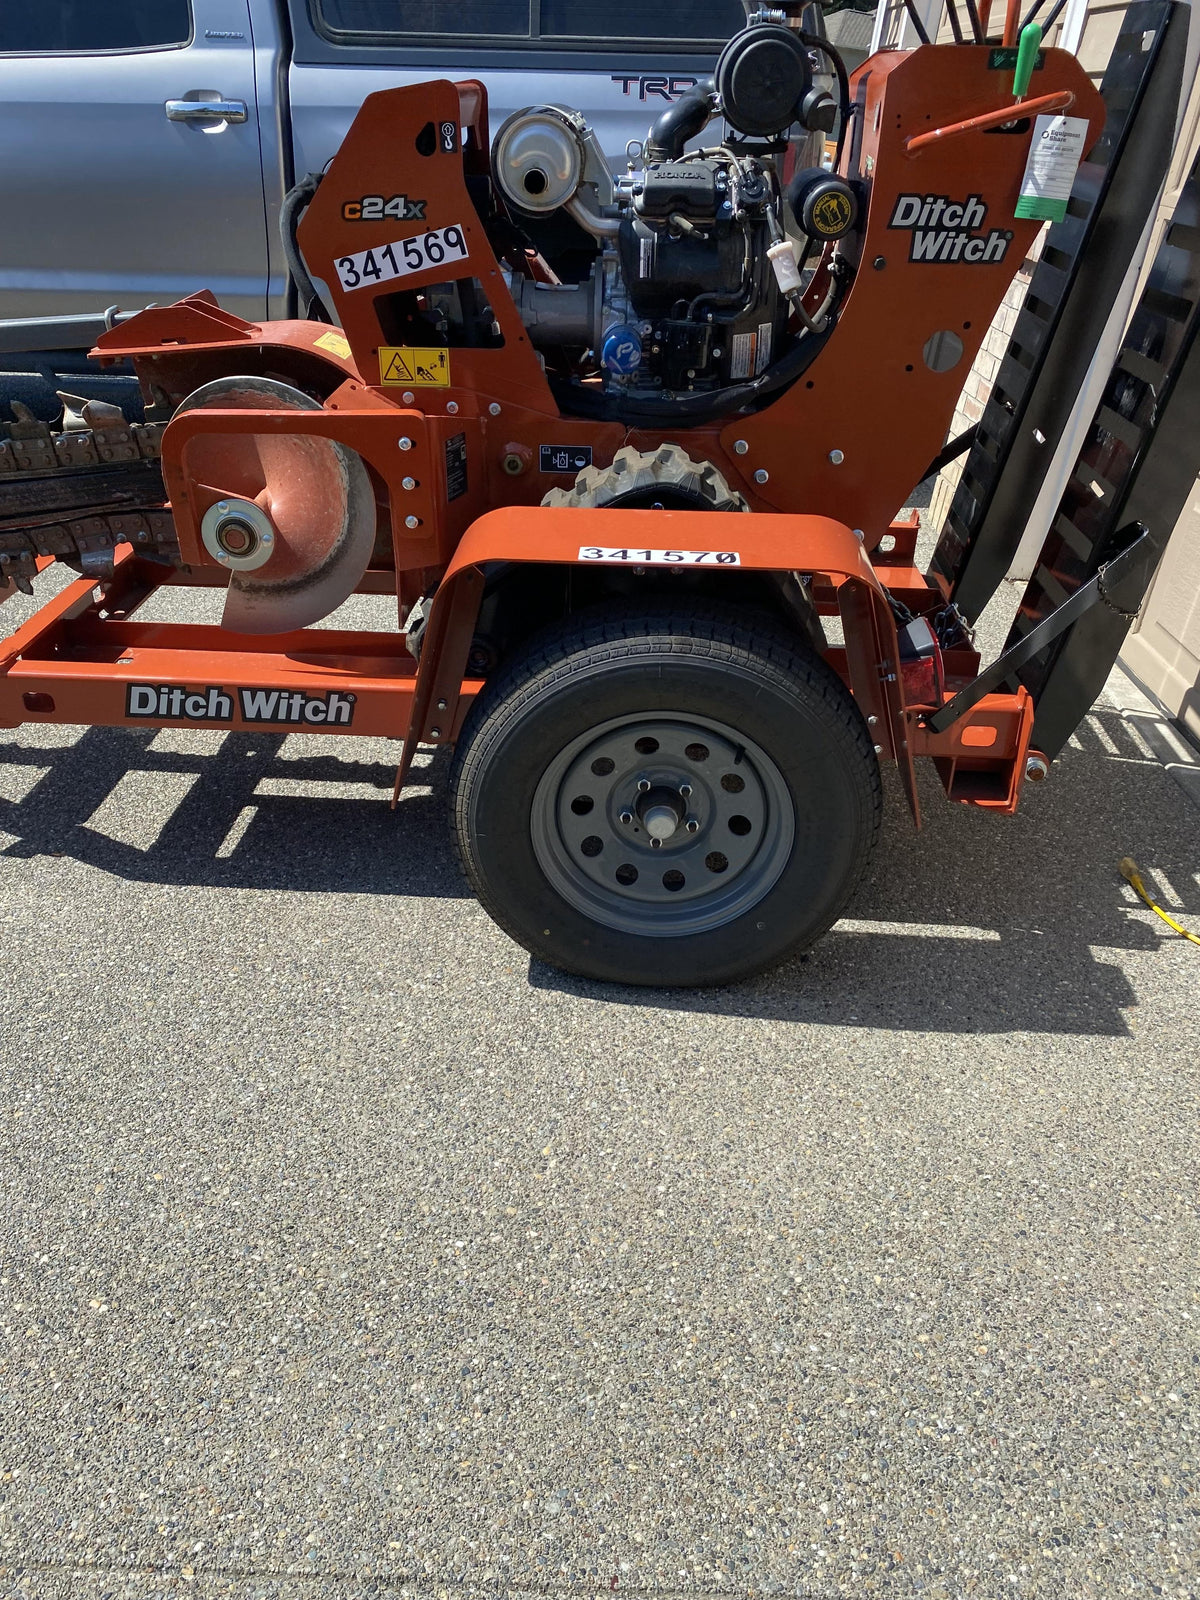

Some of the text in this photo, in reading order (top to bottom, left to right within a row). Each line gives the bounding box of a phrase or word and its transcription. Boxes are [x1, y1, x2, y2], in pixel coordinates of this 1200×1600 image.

[611, 75, 698, 102] TRD
[654, 172, 706, 180] HONDA
[891, 196, 985, 227] Ditch
[338, 226, 467, 288] 341569
[912, 231, 1009, 261] Witch
[583, 547, 737, 565] 341570
[129, 686, 231, 718] Ditch
